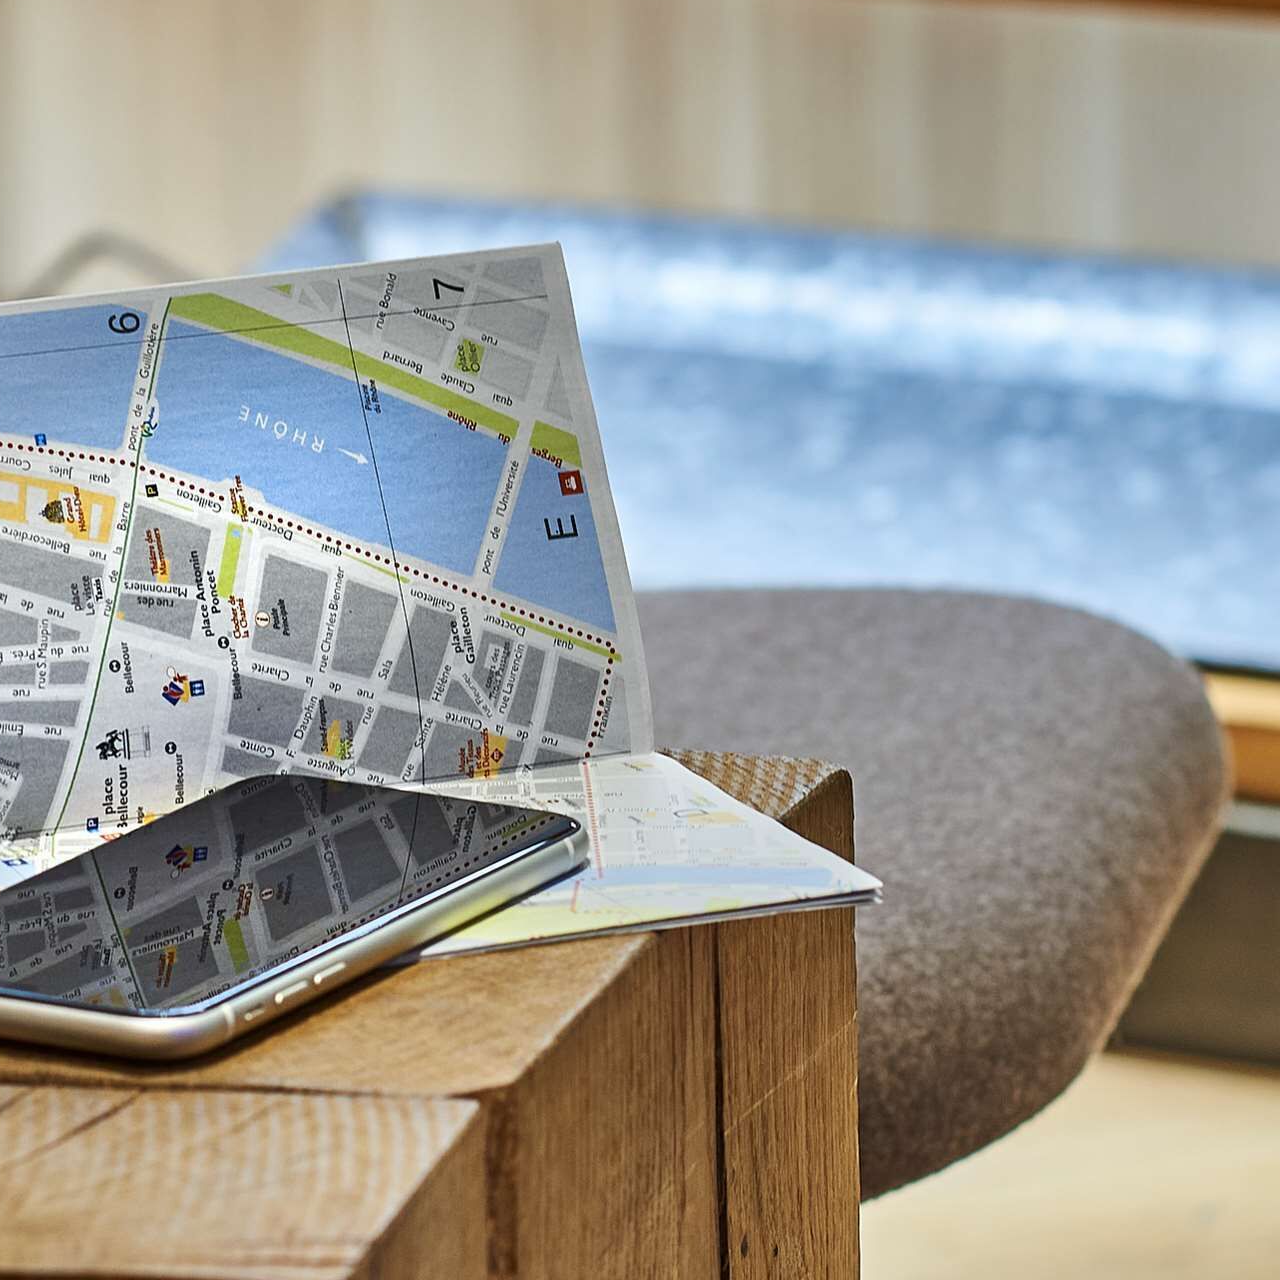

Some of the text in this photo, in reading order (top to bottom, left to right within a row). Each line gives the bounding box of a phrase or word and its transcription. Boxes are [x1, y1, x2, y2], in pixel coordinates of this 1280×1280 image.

[375, 271, 398, 331] rue Bonald
[432, 276, 466, 302] 7
[108, 311, 141, 335] 6
[413, 307, 498, 347] rue Cavenne
[128, 323, 159, 451] pont de la Guillotière
[384, 350, 512, 407] quai Claude Bernard
[447, 410, 562, 469] Berges du Rhône
[49, 465, 73, 480] Jules
[89, 474, 110, 485] quai
[176, 489, 222, 514] Gailleton
[2, 527, 70, 554] Bellecordière
[251, 518, 342, 557] Docteur quai
[544, 514, 578, 541] E
[89, 549, 107, 561] rue
[103, 599, 113, 618] rue
[111, 570, 118, 584] de
[117, 502, 130, 532] Barre
[483, 549, 495, 575] pont
[492, 526, 501, 540] de
[0, 595, 8, 605] la
[74, 583, 83, 612] place
[94, 579, 103, 601] Taxis
[124, 582, 187, 598] Marronniers
[138, 596, 174, 608] rue des
[190, 550, 214, 638] place Antonin
[205, 569, 220, 615] Poncet
[411, 589, 456, 613] Gailleton
[21, 600, 34, 611] de
[47, 608, 65, 619] rue
[320, 567, 344, 673] rue Charles Biennier
[483, 615, 574, 650] Docteur quai
[451, 620, 464, 654] place
[460, 607, 475, 665] Gailleton
[38, 619, 49, 691] rue Maupin
[50, 645, 64, 657] du
[72, 646, 89, 655] rue
[121, 641, 134, 694] Bellecour
[230, 647, 243, 700] Bellecour
[251, 663, 290, 681] Charité
[502, 643, 524, 696] Laurencin
[12, 688, 31, 697] rue
[329, 681, 342, 692] de
[357, 688, 375, 700] rue
[362, 660, 392, 726] Sala rue
[432, 664, 451, 703] Hélène
[295, 695, 318, 741] Dauphin
[444, 712, 483, 730] Charité
[44, 727, 62, 736] rue
[516, 729, 529, 740] de
[541, 736, 558, 747] rue
[239, 740, 275, 758] Comte
[174, 753, 185, 805] Bellecour
[366, 774, 385, 786] rue
[401, 763, 415, 782] rue
[102, 777, 114, 816] place
